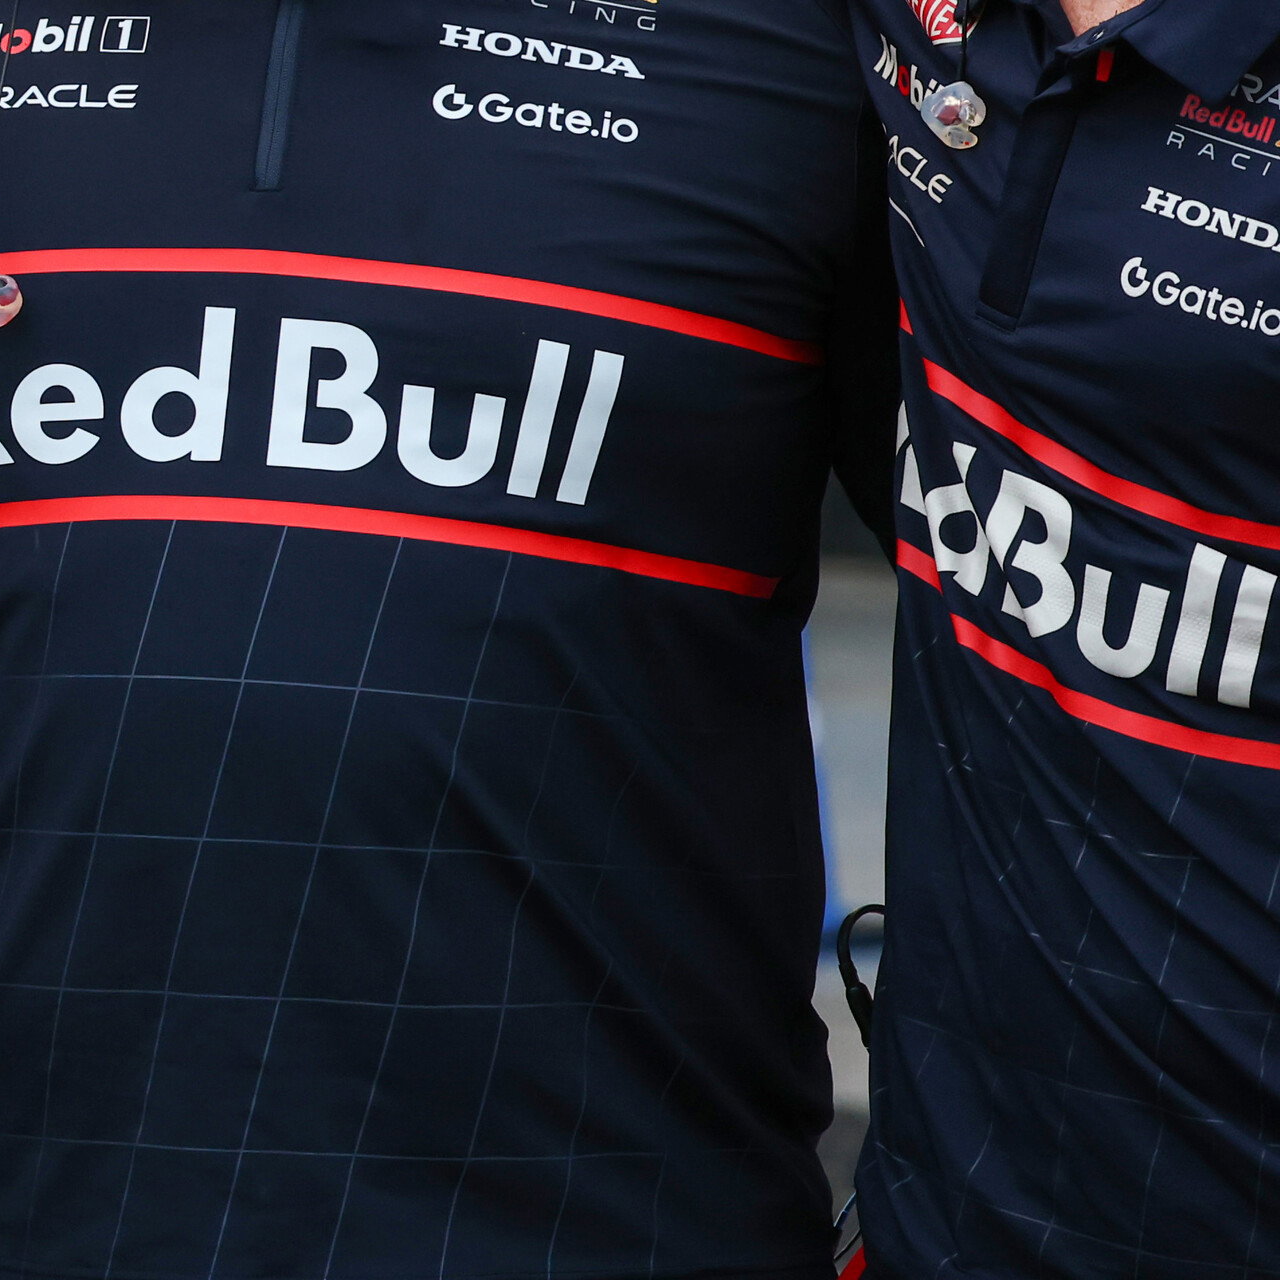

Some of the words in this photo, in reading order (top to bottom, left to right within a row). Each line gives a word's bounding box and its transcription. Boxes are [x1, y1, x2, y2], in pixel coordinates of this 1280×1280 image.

[439, 23, 646, 80] HONDA
[873, 33, 946, 112] Mobi
[478, 93, 640, 143] Gate.io
[1179, 93, 1231, 128] Red
[1225, 108, 1277, 144] Bull
[1166, 130, 1272, 177] RACI
[1141, 186, 1280, 253] HOND
[266, 317, 624, 506] Bull
[986, 469, 1279, 709] Bull
